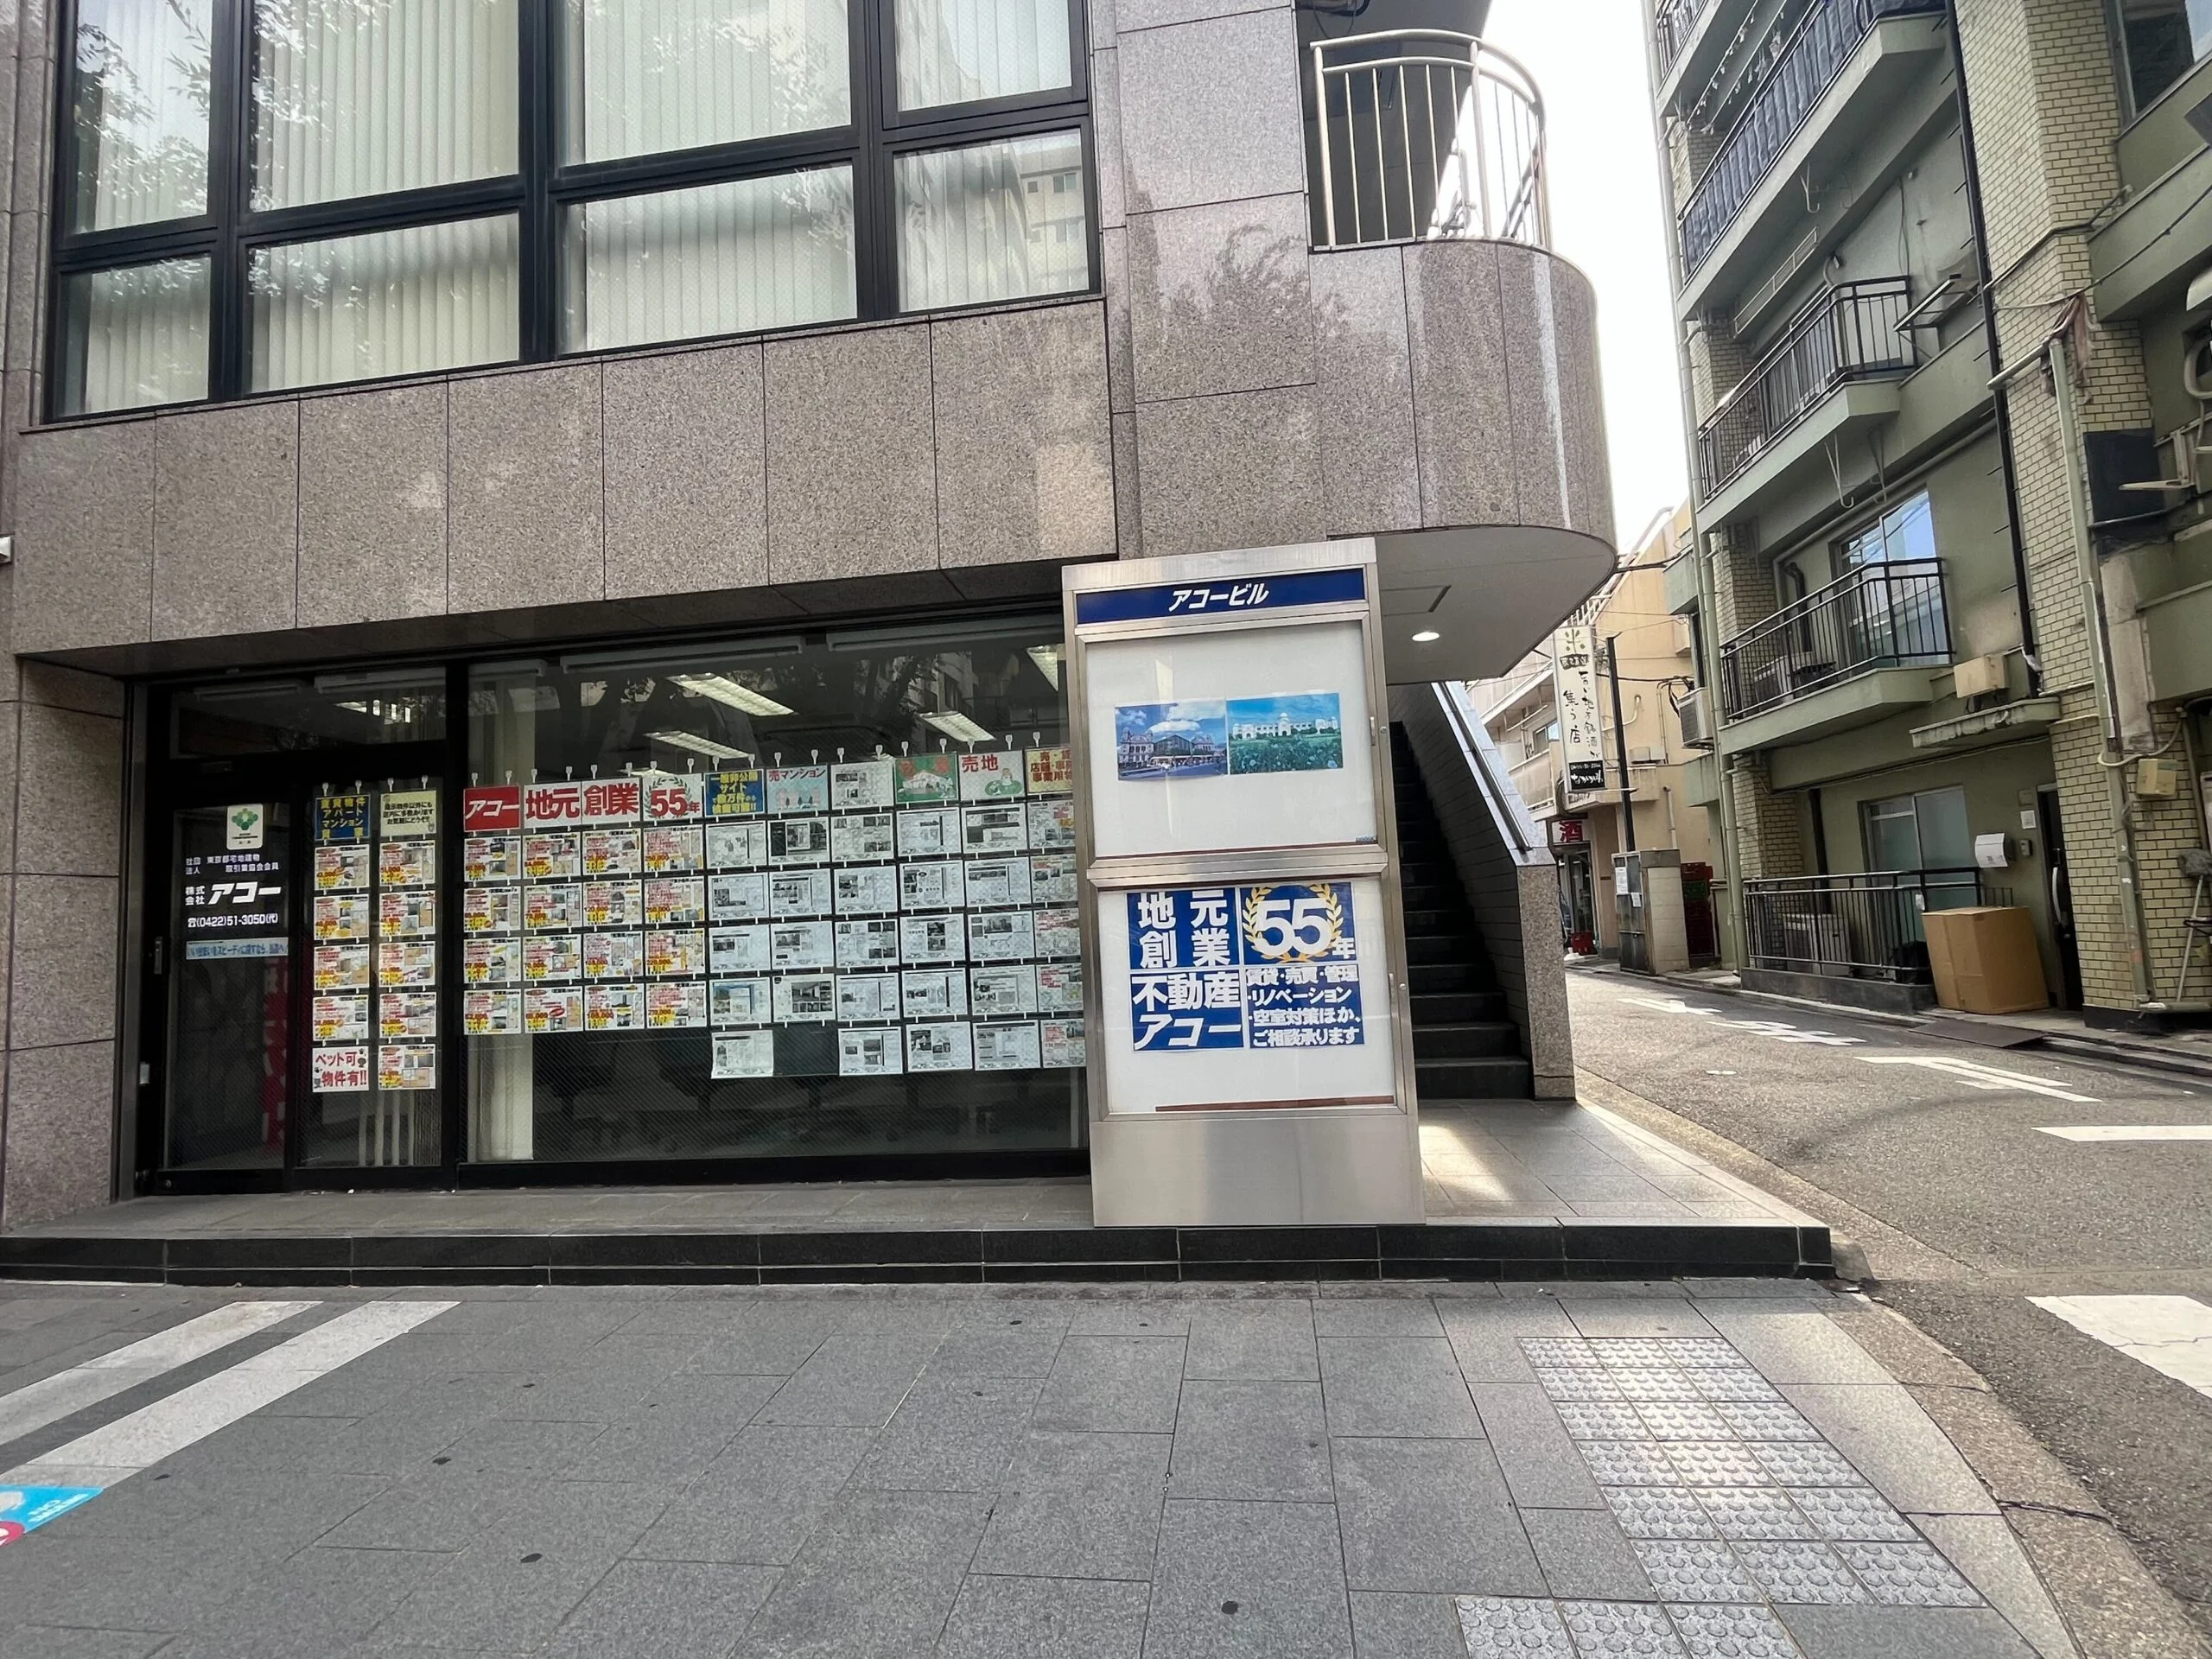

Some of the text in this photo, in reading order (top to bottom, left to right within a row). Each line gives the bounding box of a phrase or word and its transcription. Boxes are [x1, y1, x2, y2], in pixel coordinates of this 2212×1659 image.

[1168, 582, 1269, 612] アコービル
[961, 753, 999, 773] 売地
[769, 768, 826, 782] 売マンション
[465, 799, 520, 820] アコー
[524, 782, 640, 821] 地元創業
[321, 817, 364, 829] マンション
[1558, 819, 1584, 843] 酒
[207, 881, 282, 906] アコー
[1137, 889, 1229, 930] 地元
[1139, 927, 1231, 969] 創業
[1245, 964, 1359, 987] 賃貸・売買・管理
[1131, 971, 1242, 1012] 不動産
[1134, 1014, 1242, 1051] アコー
[1254, 1027, 1360, 1047] ご相談承ります
[315, 1051, 358, 1067] ペット可
[321, 1070, 367, 1087] 物件有!!
